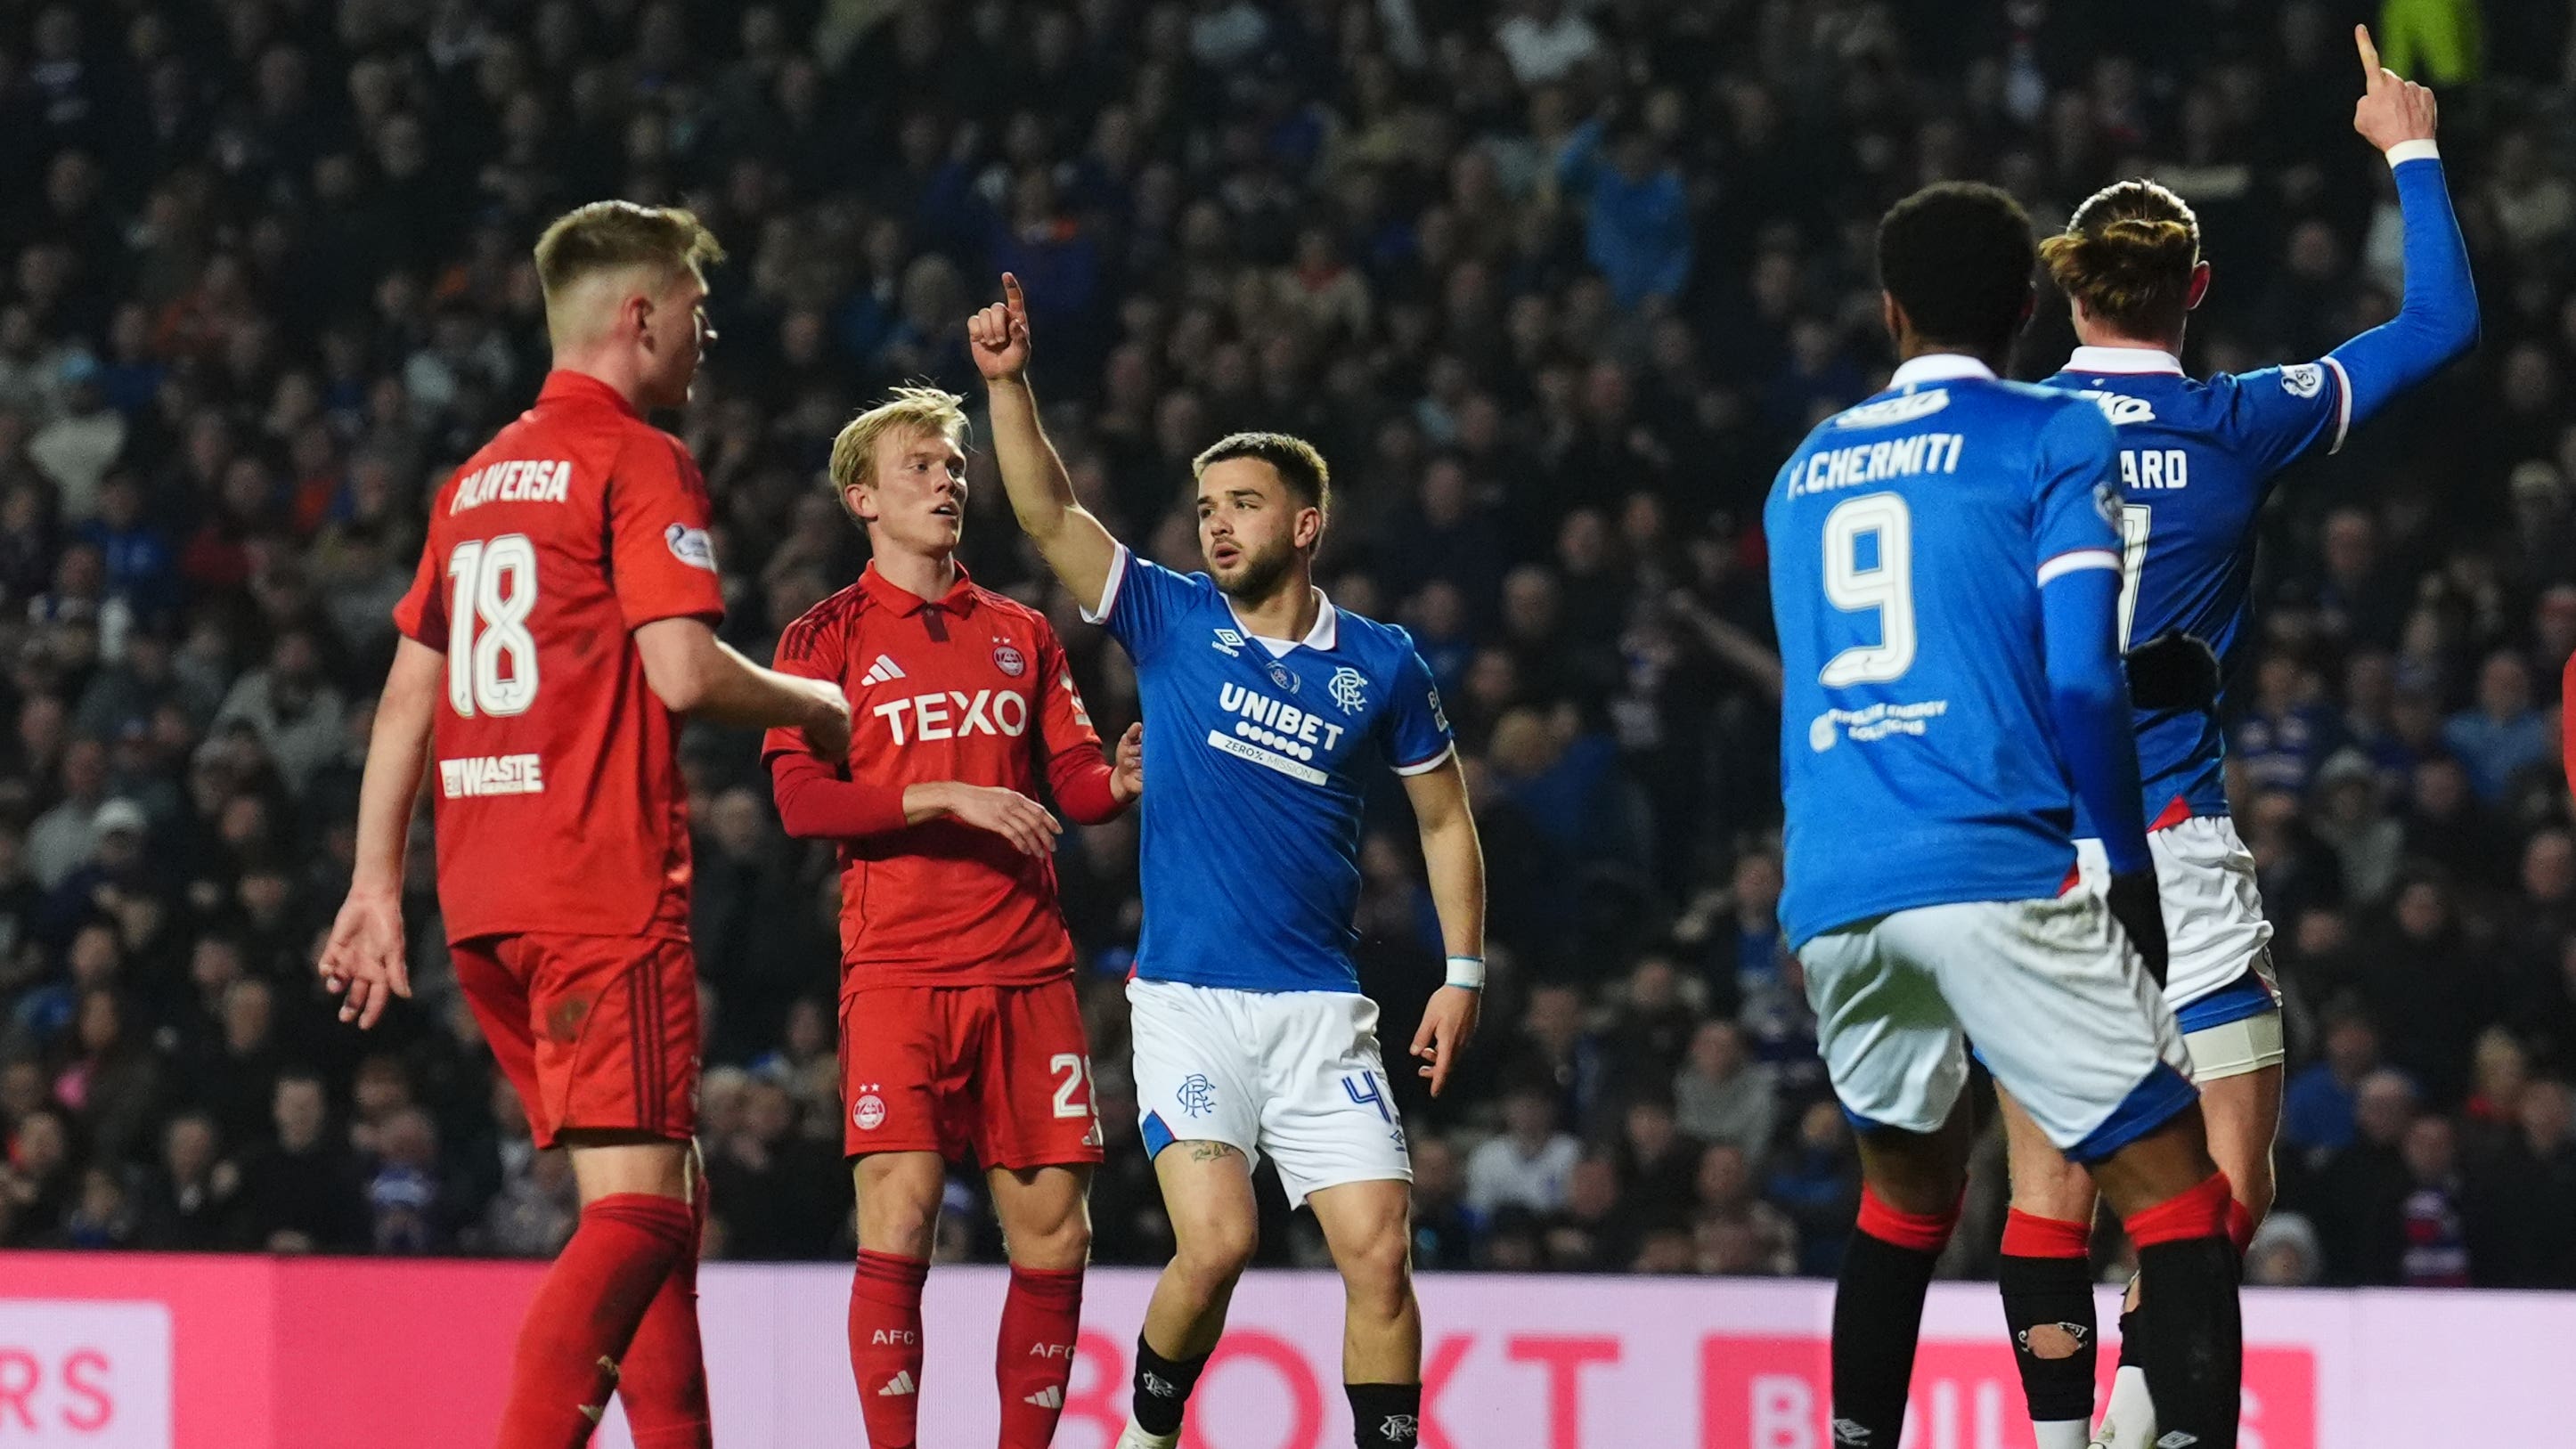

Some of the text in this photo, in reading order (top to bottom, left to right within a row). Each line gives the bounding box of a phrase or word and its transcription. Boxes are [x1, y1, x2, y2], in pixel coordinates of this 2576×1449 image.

[449, 460, 571, 517] PALAVERSA
[1819, 492, 1917, 688] 9
[448, 533, 539, 718] 18
[873, 689, 1027, 746] TEXO
[1219, 681, 1344, 751] UNIBET
[461, 753, 545, 796] WASTE
[1267, 755, 1313, 778] MISSION
[1050, 1053, 1099, 1119] 2
[872, 1329, 915, 1346] AFC
